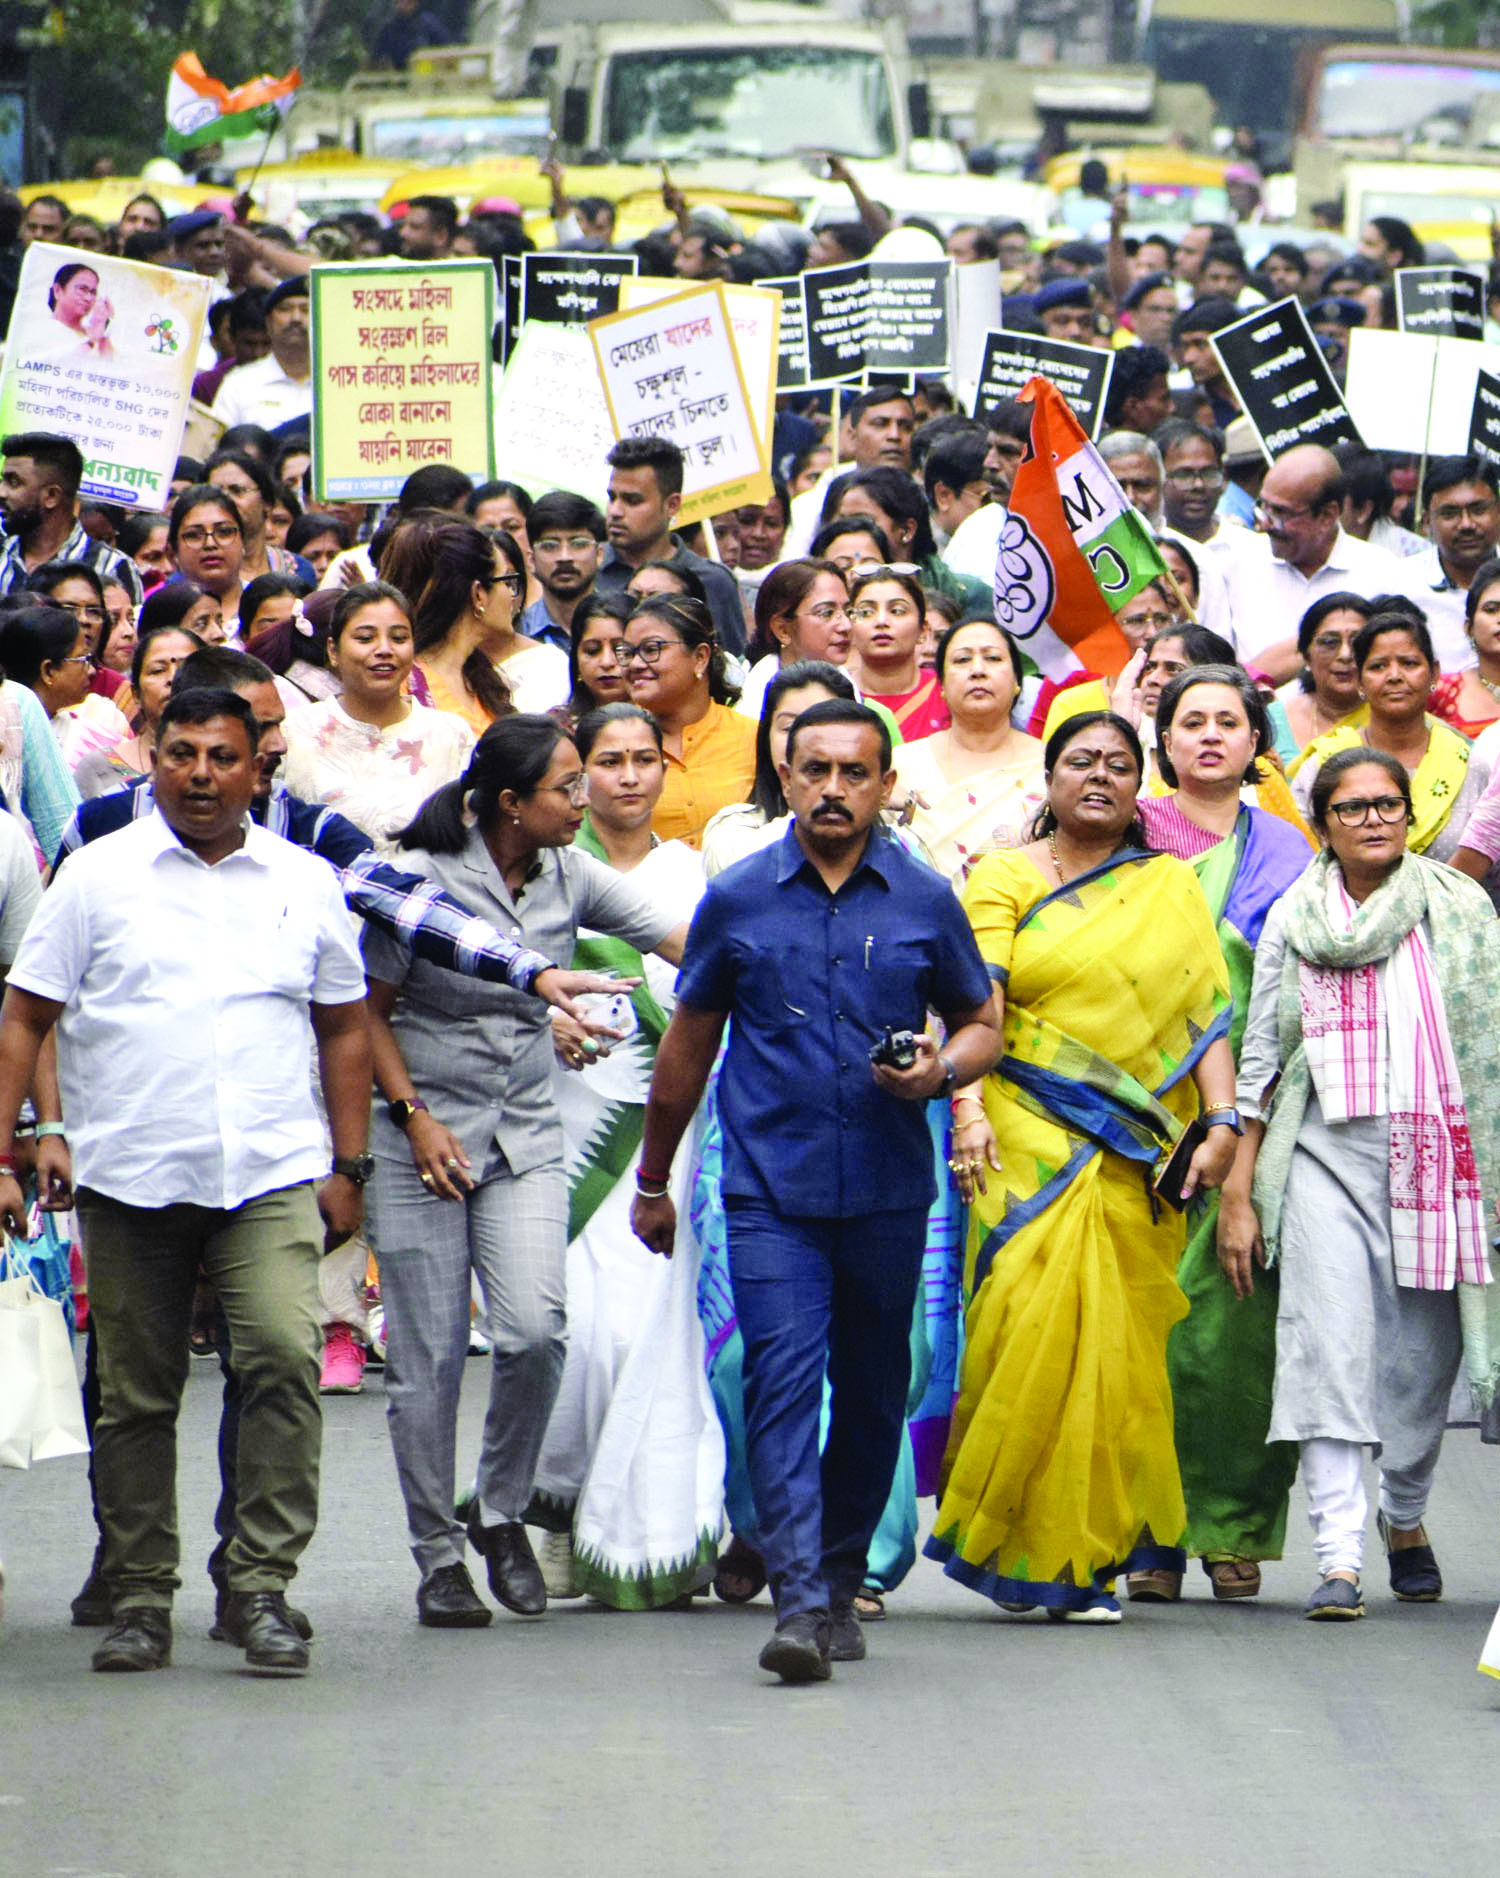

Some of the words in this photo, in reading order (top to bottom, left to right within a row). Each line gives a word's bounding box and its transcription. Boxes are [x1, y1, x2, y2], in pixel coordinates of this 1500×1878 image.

[352, 288, 404, 312] সংসদে
[408, 279, 453, 310] মহিলা
[358, 325, 418, 352] সংরক্ষণ
[422, 317, 449, 348] বিল
[610, 333, 661, 368] মেয়েরা
[664, 317, 714, 348] যাদের
[16, 358, 62, 377] LAMPS
[65, 369, 83, 381] এর
[328, 364, 358, 389] পাস
[362, 356, 406, 390] করিয়ে
[409, 354, 481, 388] মহিলাদের
[634, 365, 689, 400] চক্ষুশূল
[18, 378, 52, 395] মহিলা
[56, 386, 111, 408] পরিচালিত
[115, 400, 144, 415] SHG
[148, 406, 170, 420] দের
[358, 402, 396, 425] বোকা
[399, 400, 453, 424] বানানো
[628, 410, 676, 439] তাদের
[679, 393, 731, 426] চিনতে
[138, 423, 164, 440] টাকা
[358, 431, 402, 465] যায়নি
[406, 437, 453, 461] যাবেনা
[695, 435, 726, 465] ভুল
[83, 457, 163, 491] ধন্যবাদ
